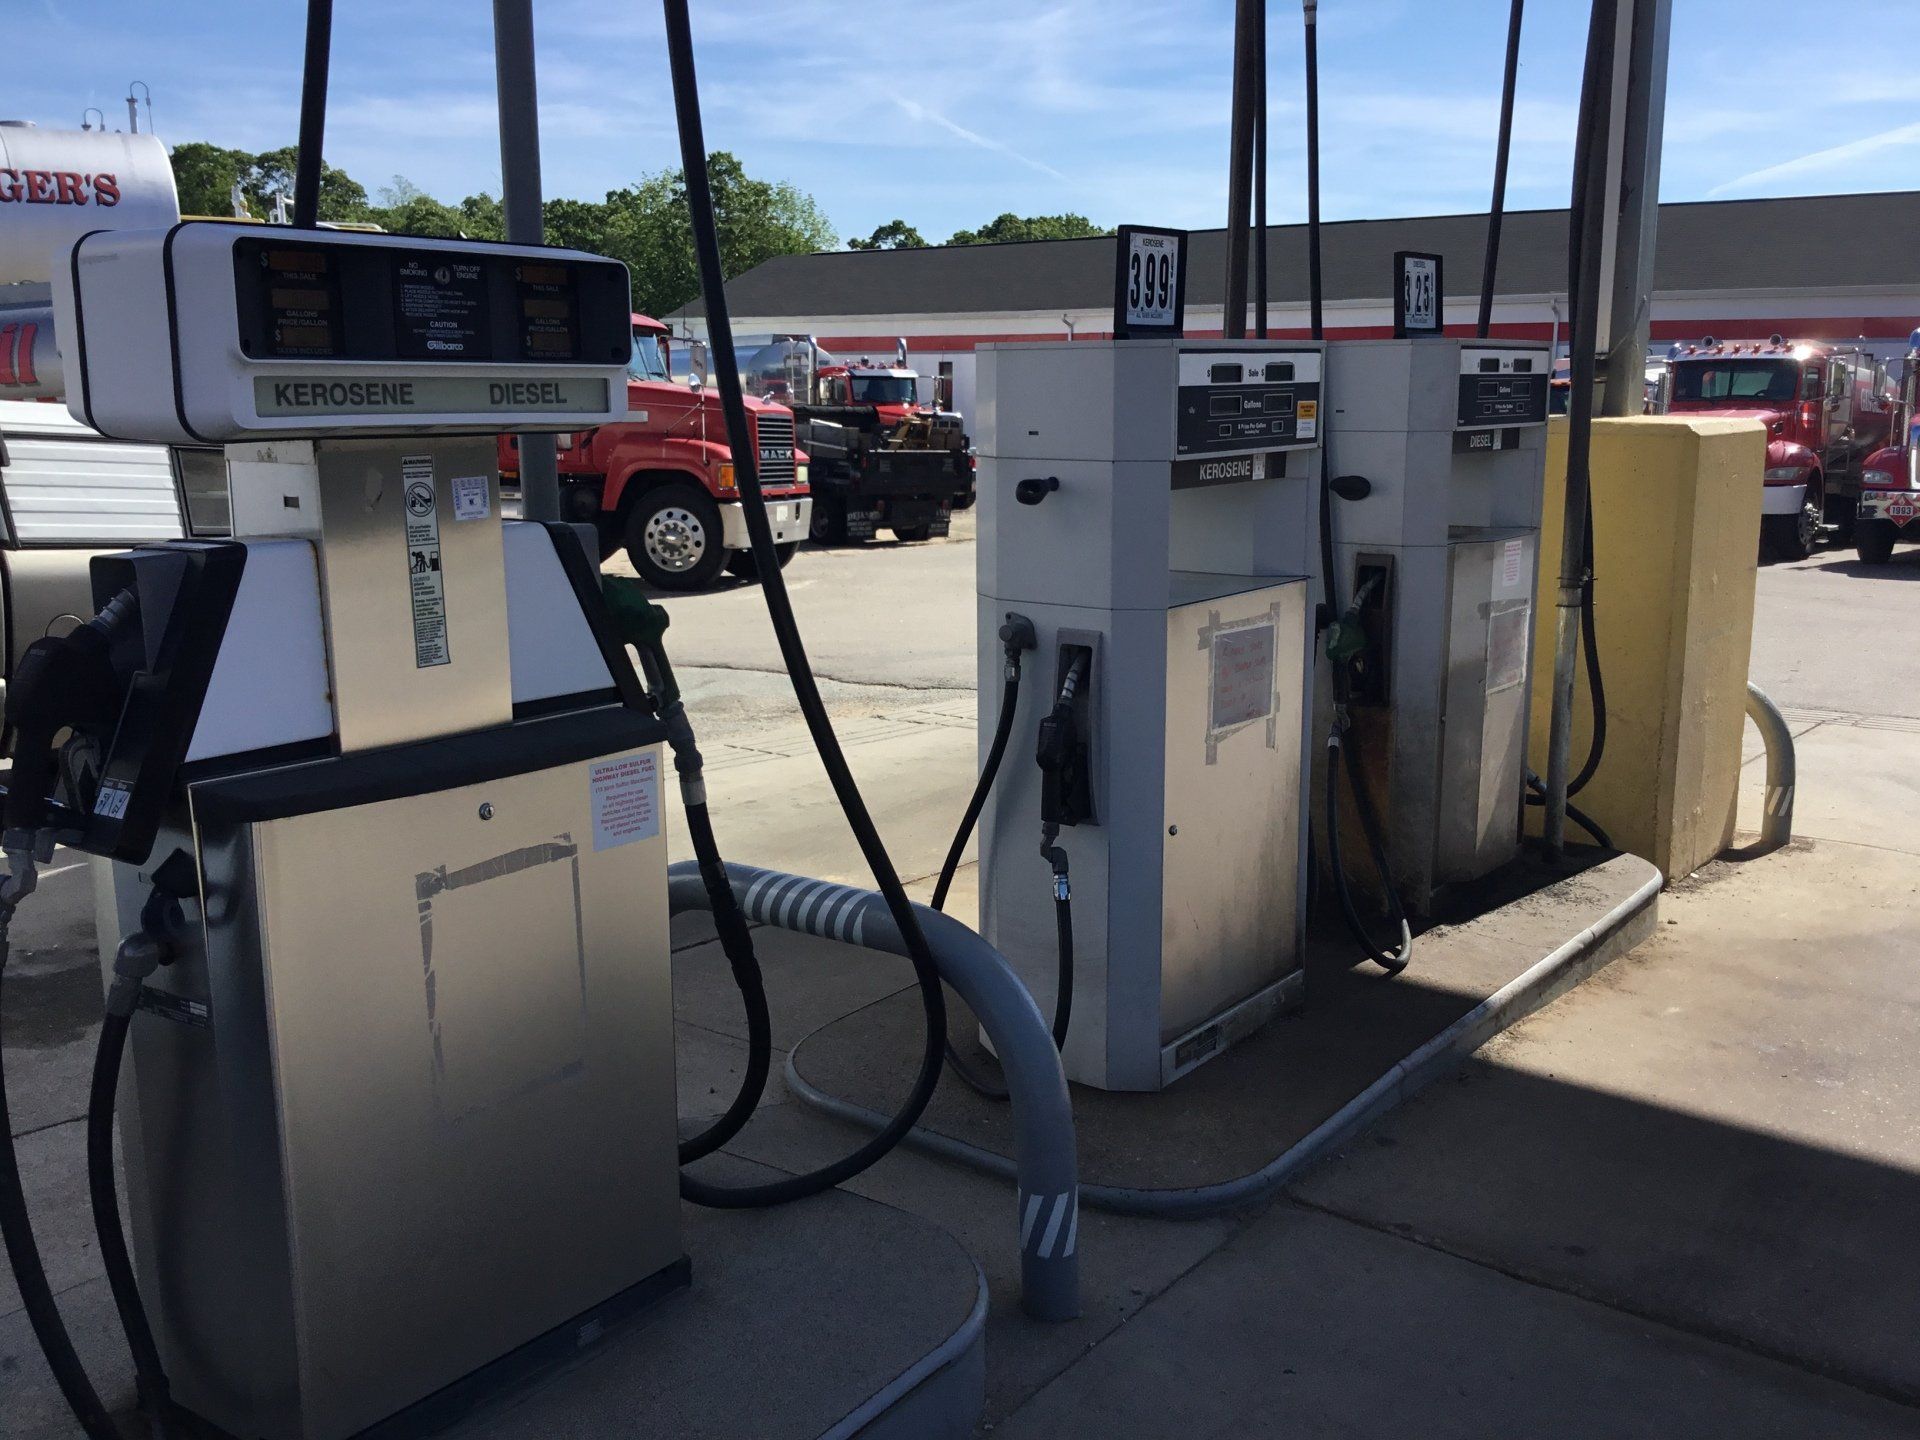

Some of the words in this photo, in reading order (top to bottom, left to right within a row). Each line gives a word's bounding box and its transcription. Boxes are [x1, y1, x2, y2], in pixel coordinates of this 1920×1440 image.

[0, 168, 121, 207] GER'S
[1142, 238, 1165, 248] KEROSENE
[426, 340, 464, 351] Gilbarco
[1248, 369, 1259, 377] Sale
[274, 382, 415, 407] KEROSENE
[489, 382, 568, 405] DIESEL
[1243, 400, 1262, 409] Gallons
[1470, 434, 1492, 448] DIESEL
[759, 450, 793, 459] MACK
[1199, 460, 1251, 481] KEROSENE
[1891, 506, 1912, 515] 1993
[595, 765, 628, 775] ULTRA-LOW
[630, 759, 651, 768] SULFUR
[621, 769, 640, 778] DIESEL
